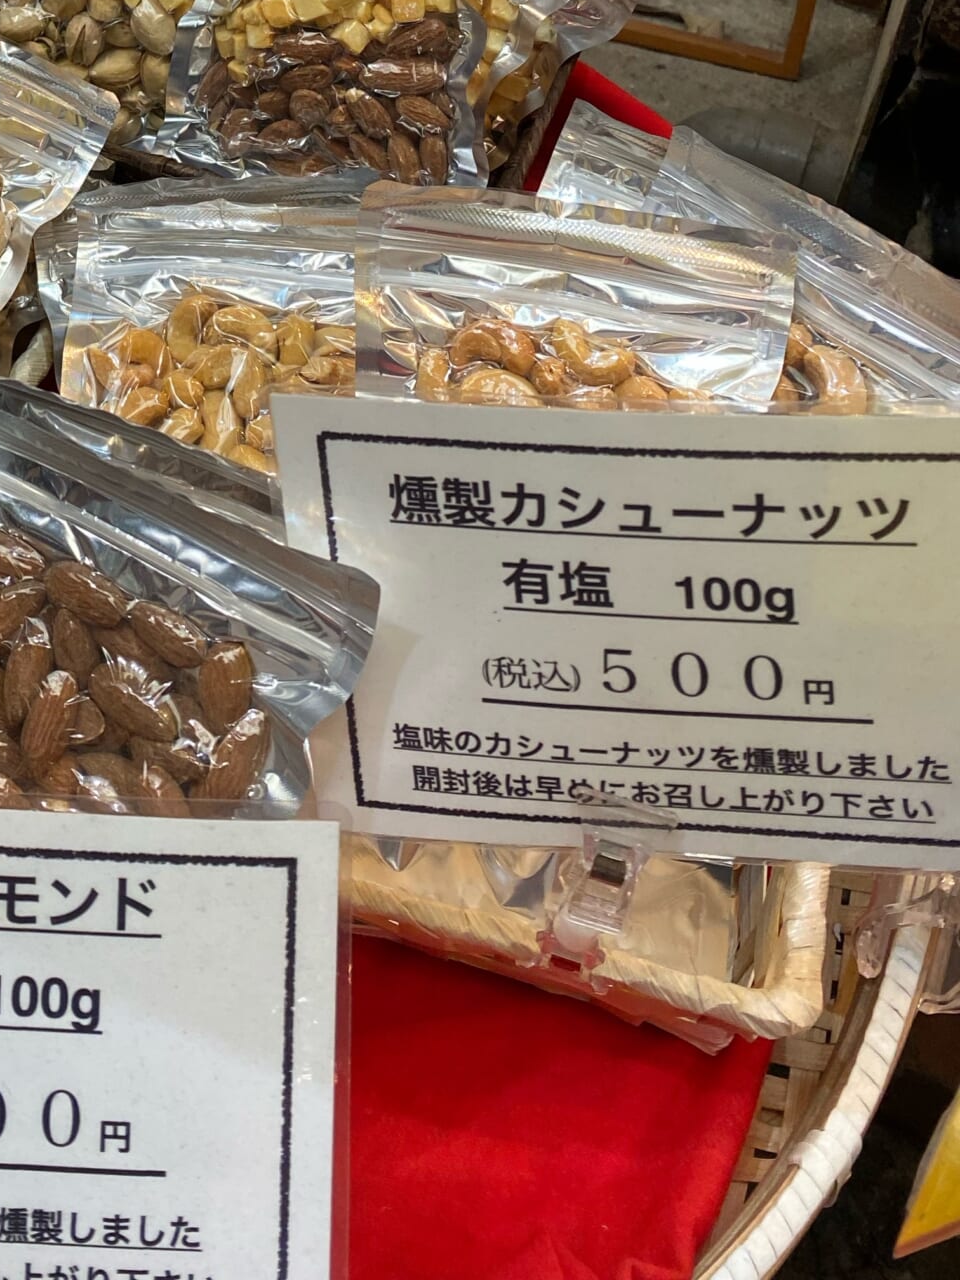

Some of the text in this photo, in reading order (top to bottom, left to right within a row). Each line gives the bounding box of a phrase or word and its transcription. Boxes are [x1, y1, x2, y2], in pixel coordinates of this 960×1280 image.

[389, 474, 911, 540] 燻製カシューナッツ
[502, 559, 797, 621] 有塩 100g
[392, 723, 950, 782] 塩味のカシューナッツを燻製しました
[412, 764, 934, 821] 開封後は早めにお召し上がり下さい
